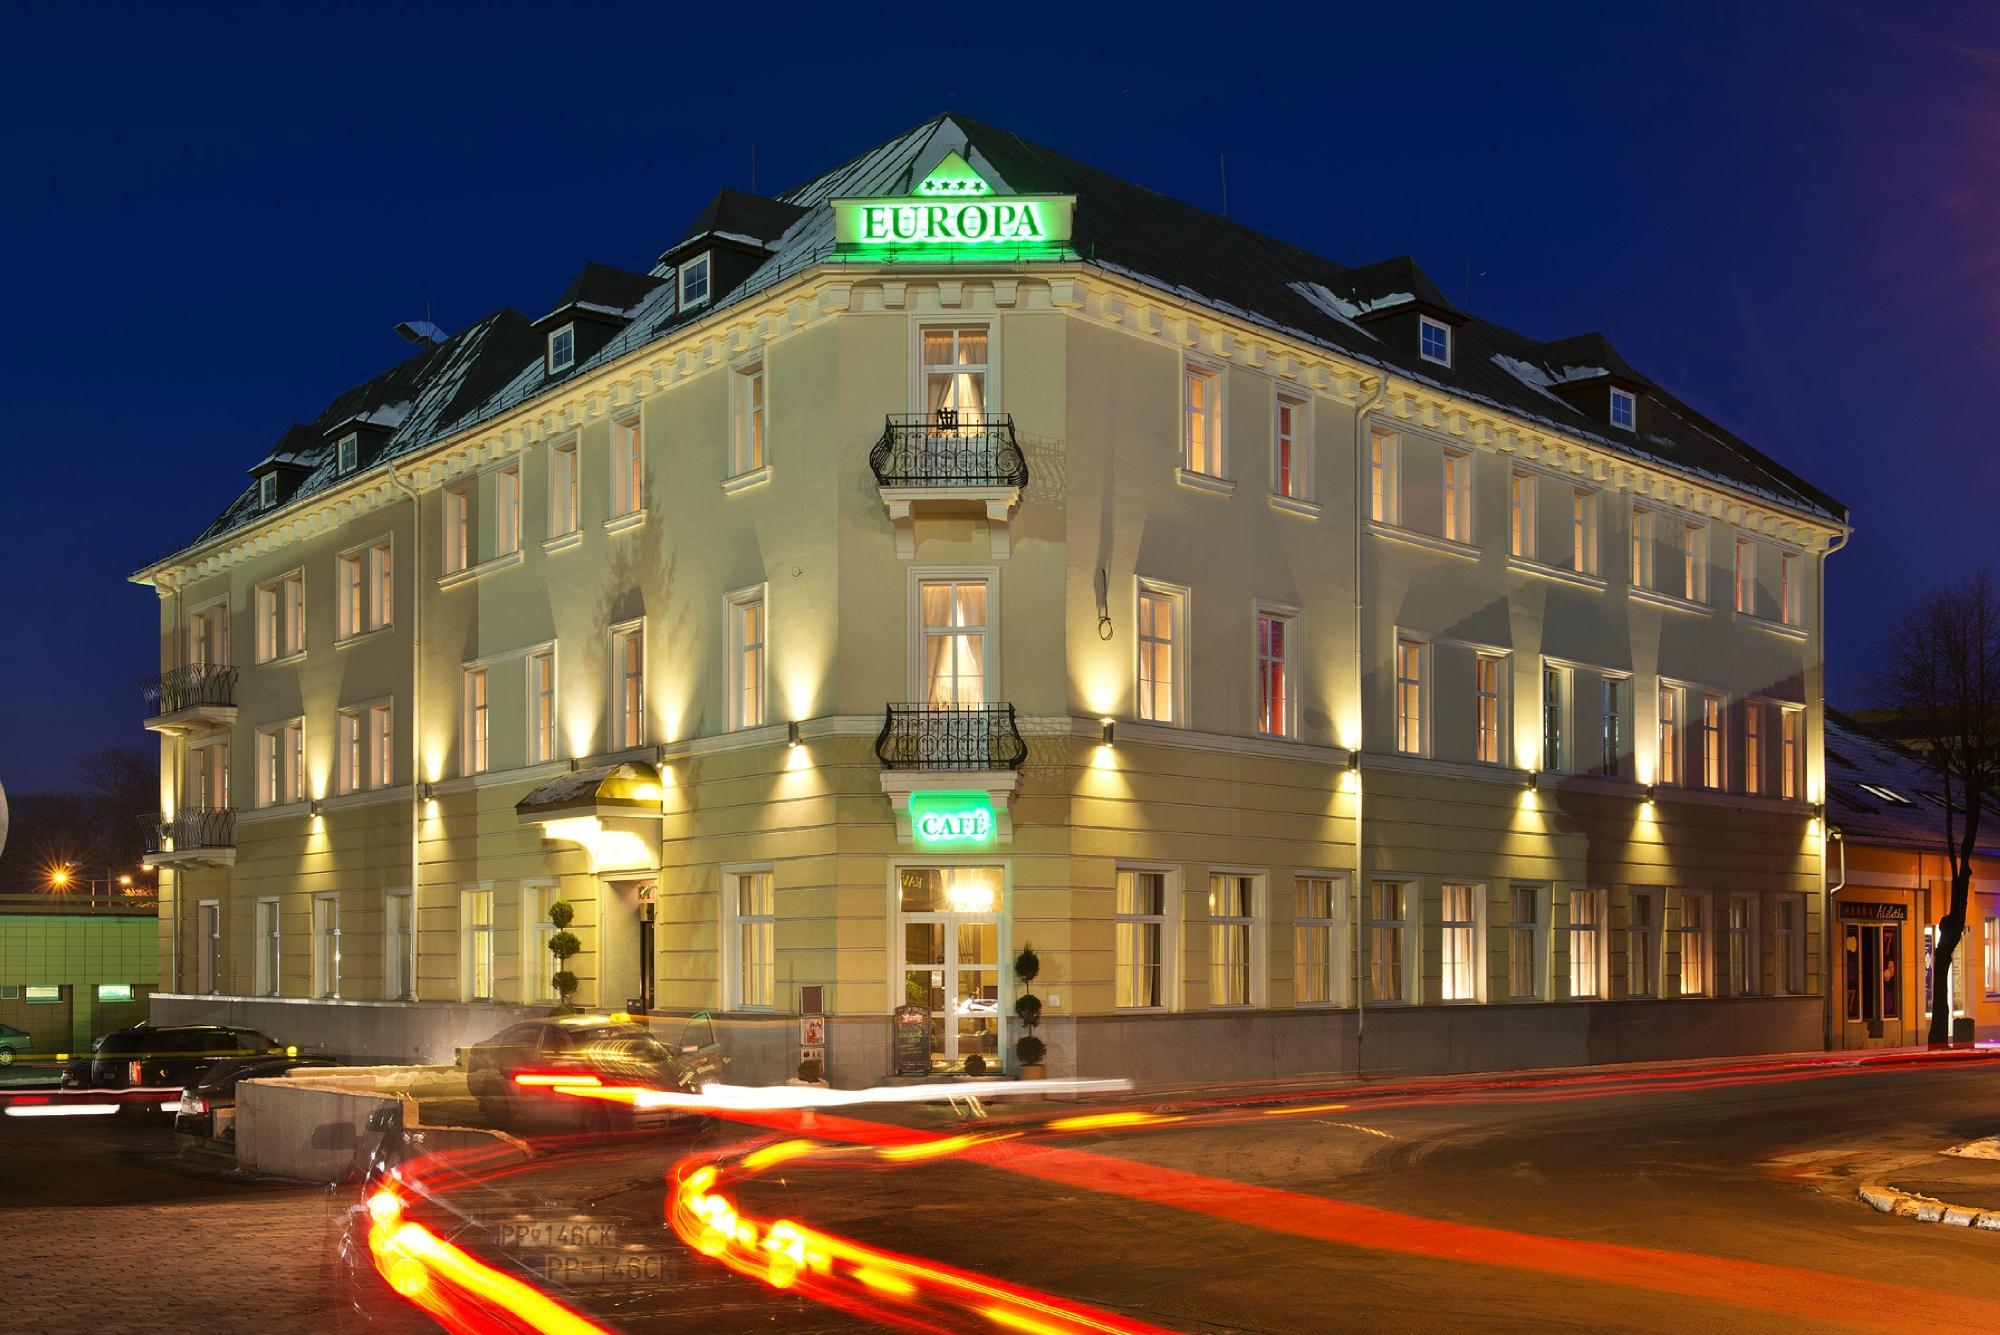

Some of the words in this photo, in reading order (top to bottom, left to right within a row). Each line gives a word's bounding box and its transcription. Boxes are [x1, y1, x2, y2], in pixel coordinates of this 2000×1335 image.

[861, 205, 1043, 239] EUROPA
[922, 813, 986, 835] CAFÉ
[501, 1225, 530, 1247] PP
[545, 1224, 612, 1247] 146CK
[549, 1256, 581, 1280] PP
[600, 1256, 673, 1280] 146CK
